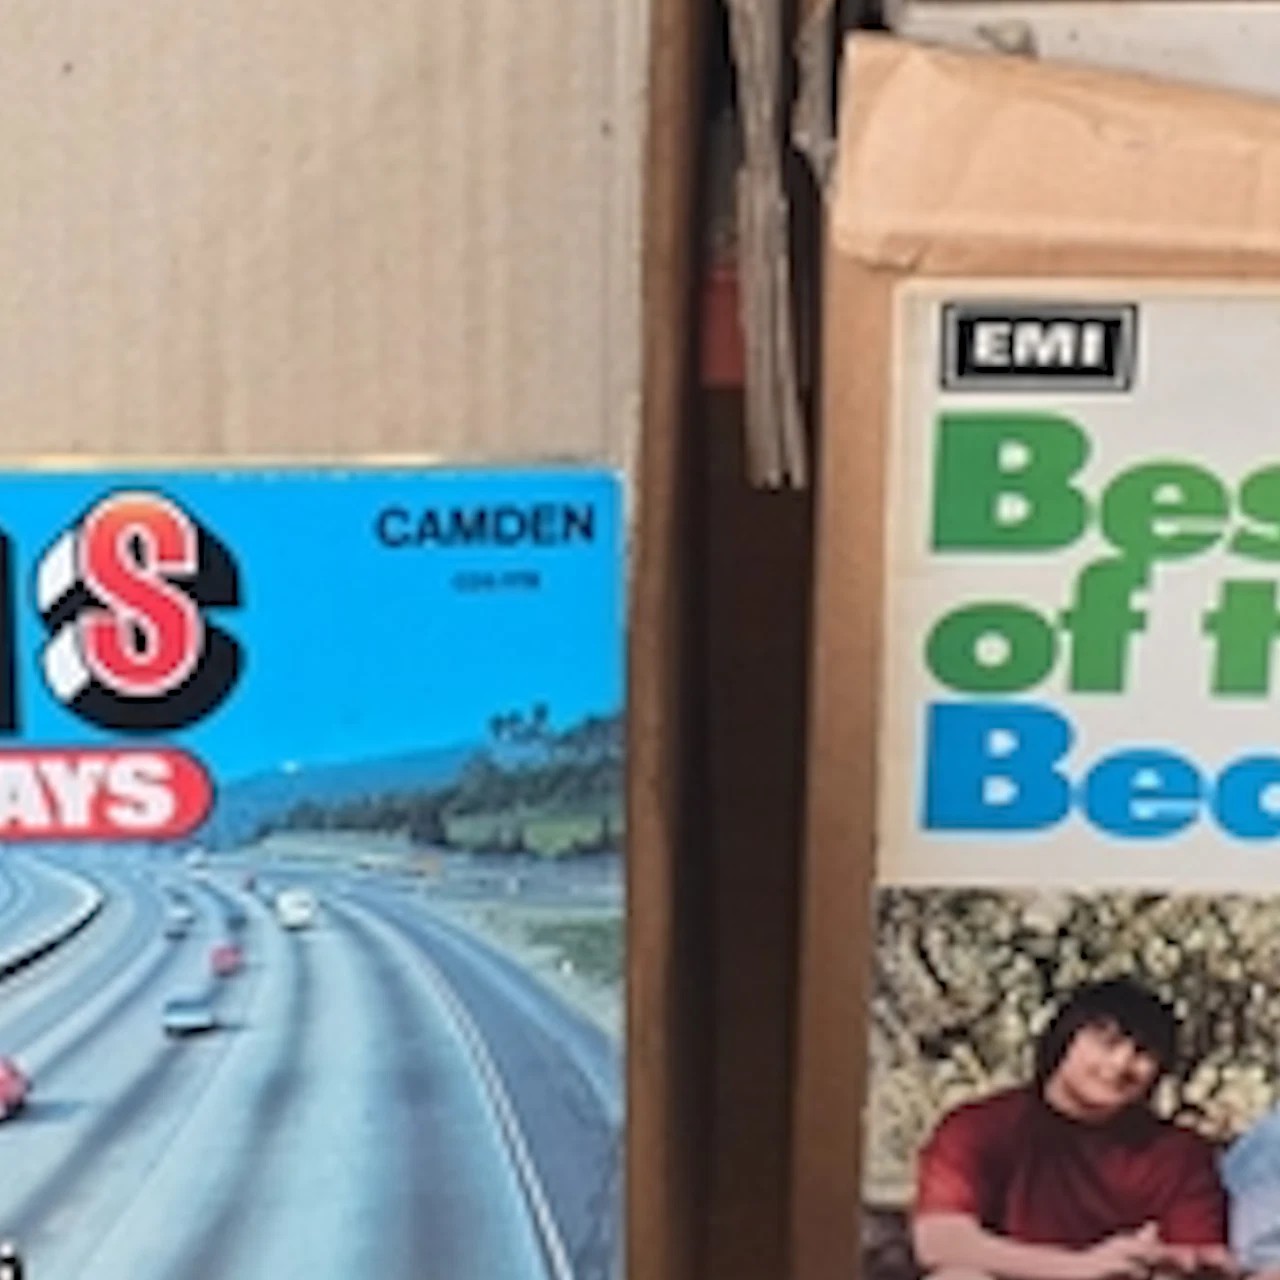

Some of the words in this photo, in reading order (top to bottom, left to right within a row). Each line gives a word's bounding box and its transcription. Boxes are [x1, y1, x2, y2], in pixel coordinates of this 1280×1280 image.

[974, 324, 1104, 366] EMI
[376, 503, 595, 548] CAMDEN
[925, 558, 1152, 693] of
